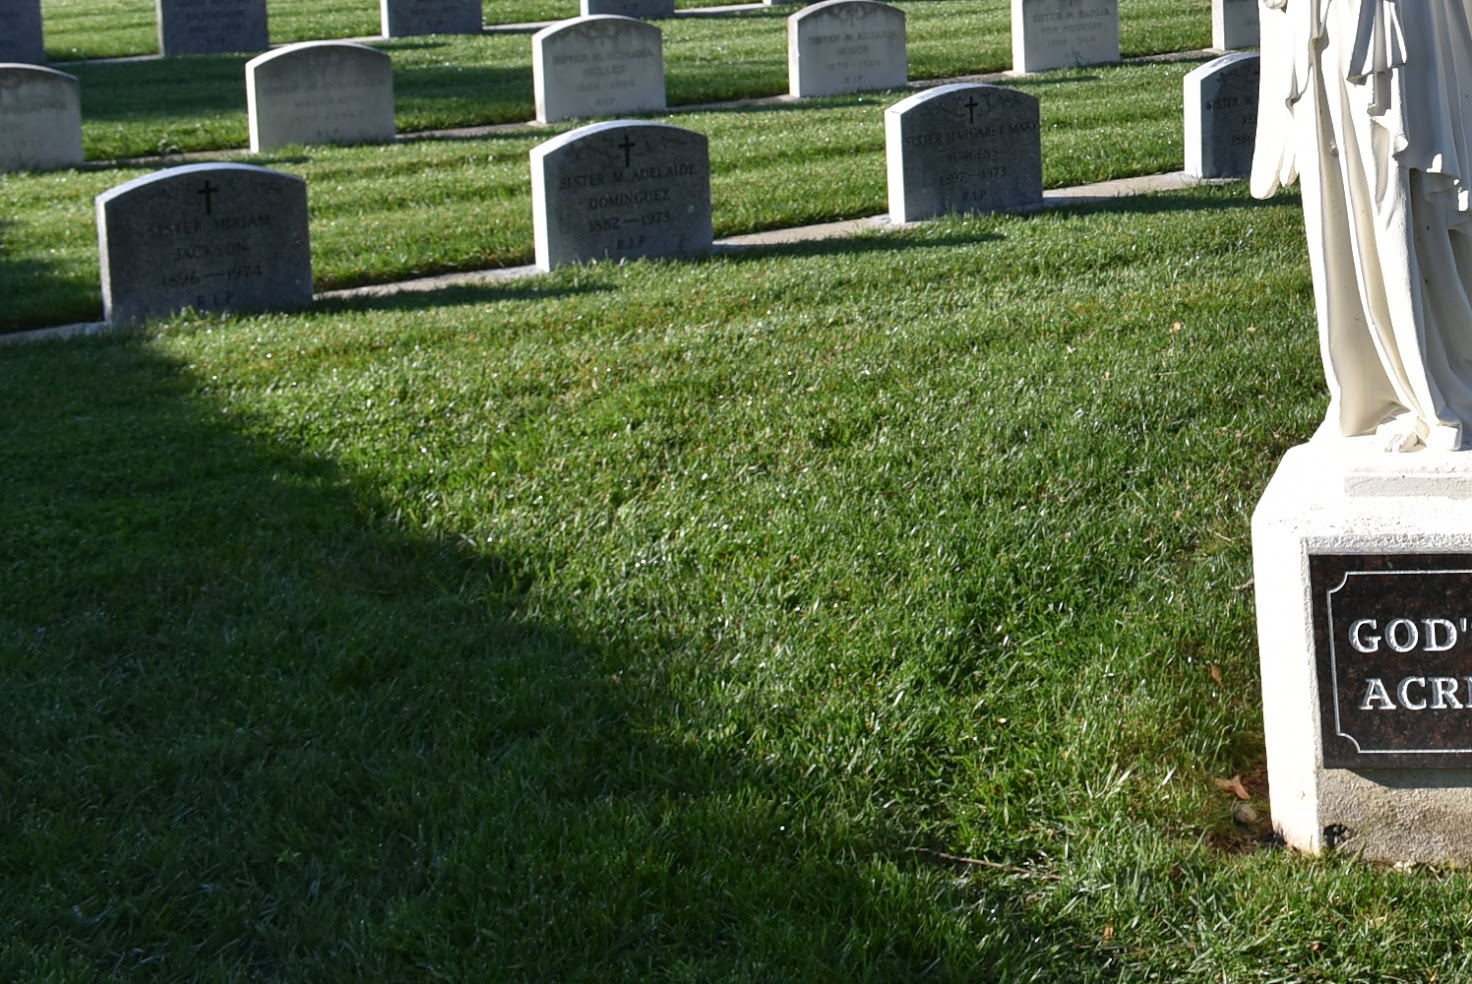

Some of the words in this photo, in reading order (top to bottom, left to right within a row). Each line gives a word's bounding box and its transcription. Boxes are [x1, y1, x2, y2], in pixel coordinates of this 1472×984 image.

[1206, 96, 1239, 110] SISTER
[905, 132, 943, 147] SISTER
[946, 125, 1005, 144] MARGARET
[1008, 120, 1039, 134] MARY
[559, 174, 604, 190] SISTER
[632, 163, 697, 182] ADELAIDE
[588, 188, 671, 211] DOMINGUEZ
[147, 218, 200, 238] SISTER
[174, 241, 250, 262] JACKSON
